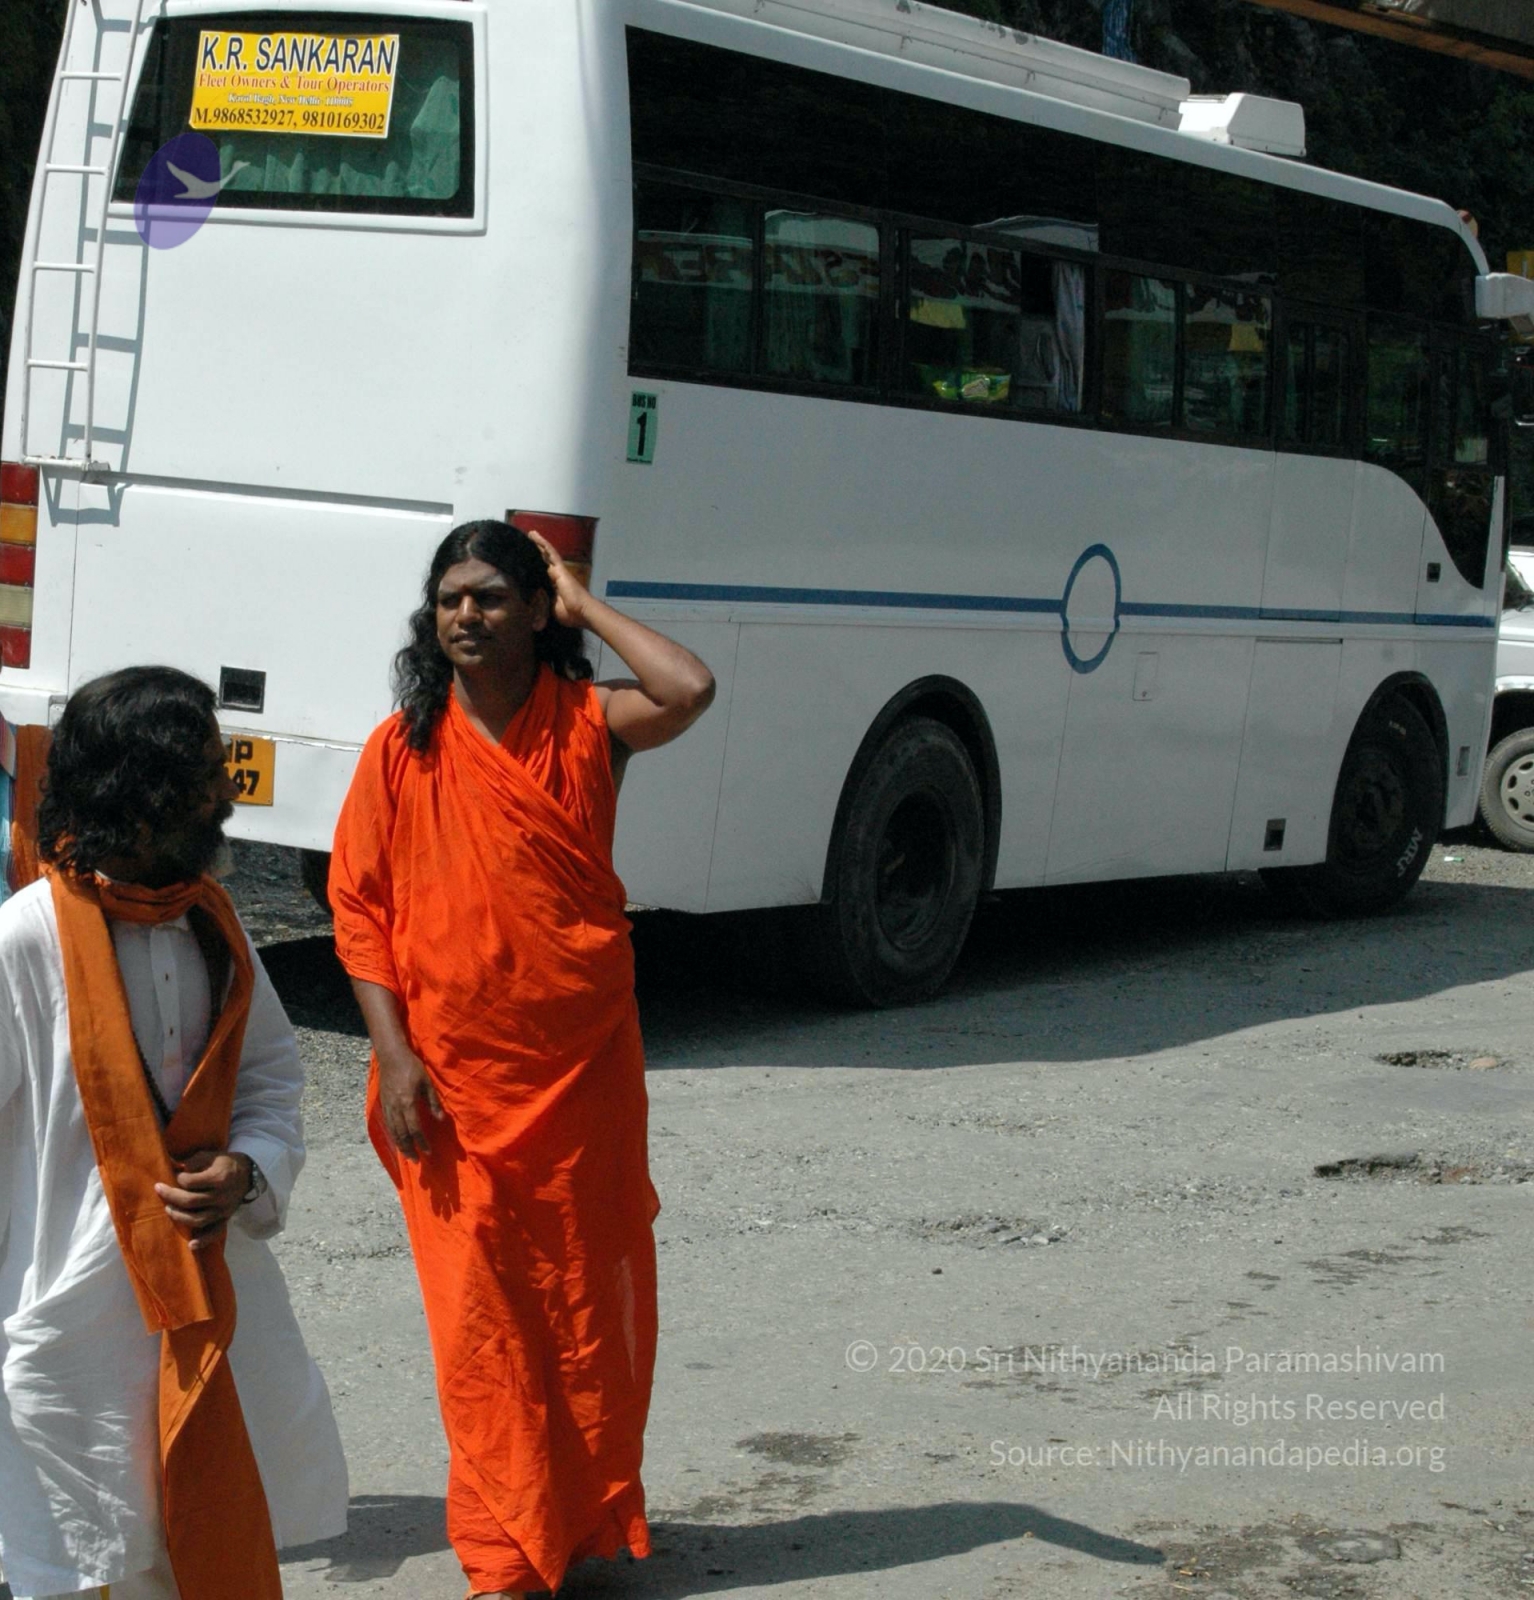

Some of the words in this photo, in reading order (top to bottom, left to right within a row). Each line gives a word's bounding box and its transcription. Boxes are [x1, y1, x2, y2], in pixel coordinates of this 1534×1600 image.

[202, 36, 246, 70] K.R.
[256, 37, 394, 75] SANKARAN
[199, 74, 226, 88] Fleet
[231, 75, 276, 89] Owners
[280, 76, 290, 89] &
[297, 76, 323, 90] Tour
[327, 77, 390, 95] Operators
[301, 110, 384, 130] 9810169302
[637, 412, 647, 457] 1
